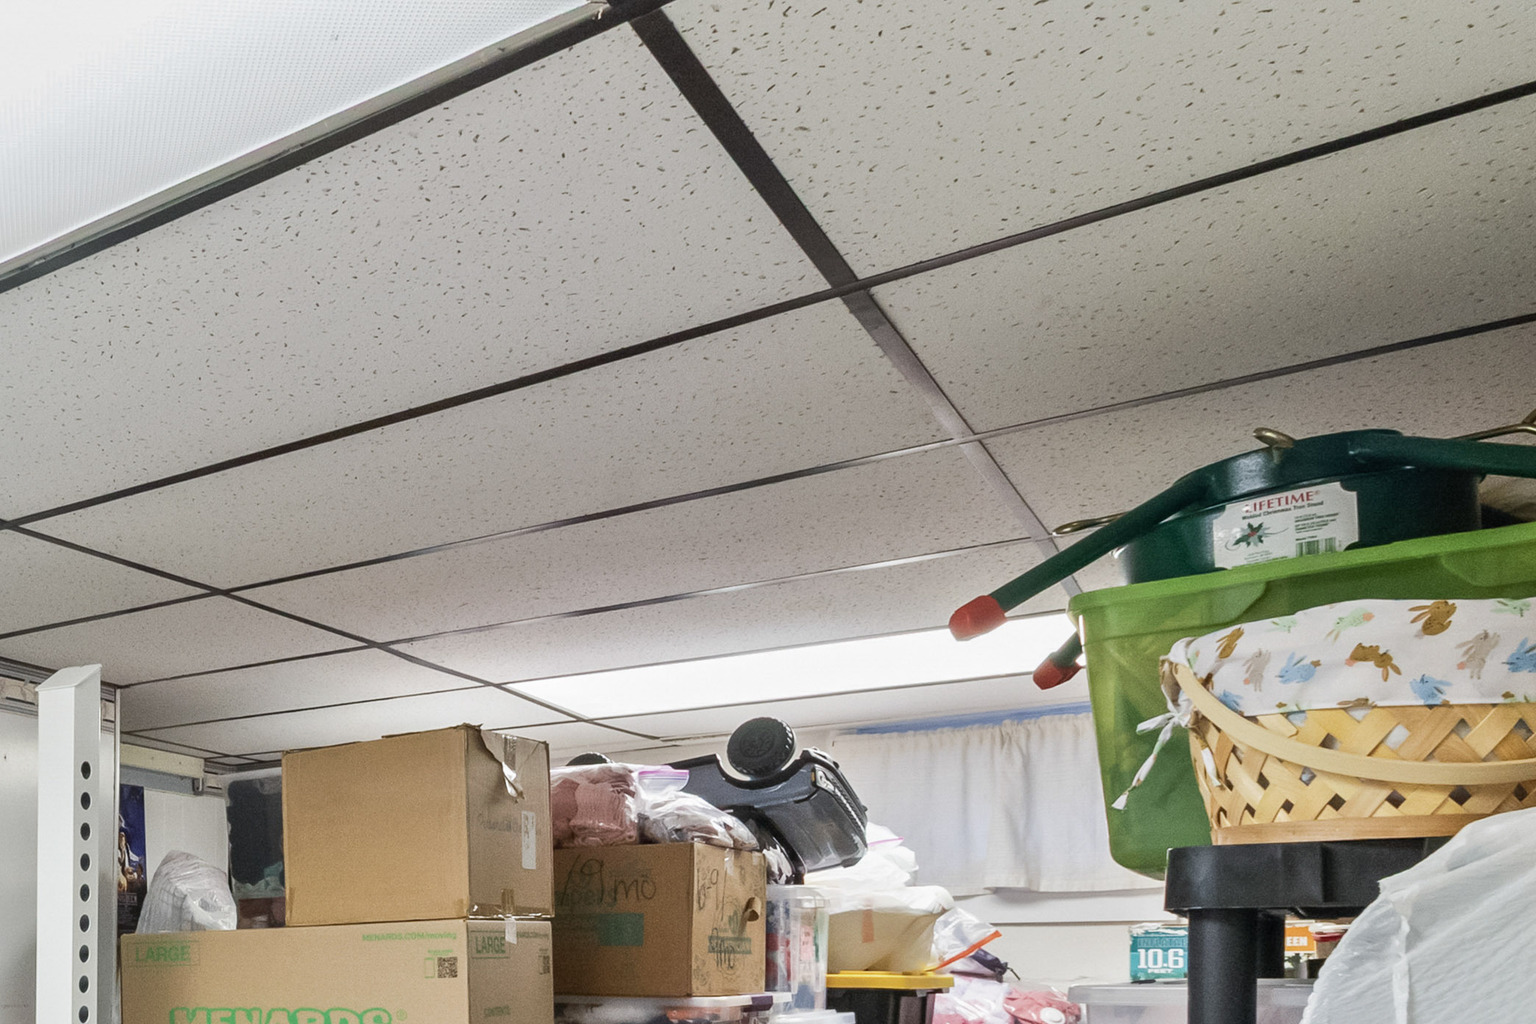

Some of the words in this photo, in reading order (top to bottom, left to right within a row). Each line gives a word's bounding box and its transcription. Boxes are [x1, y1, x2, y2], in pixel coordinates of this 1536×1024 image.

[135, 944, 191, 963] LARGE
[475, 936, 506, 954] LARGE
[1137, 948, 1184, 969] 10.6
